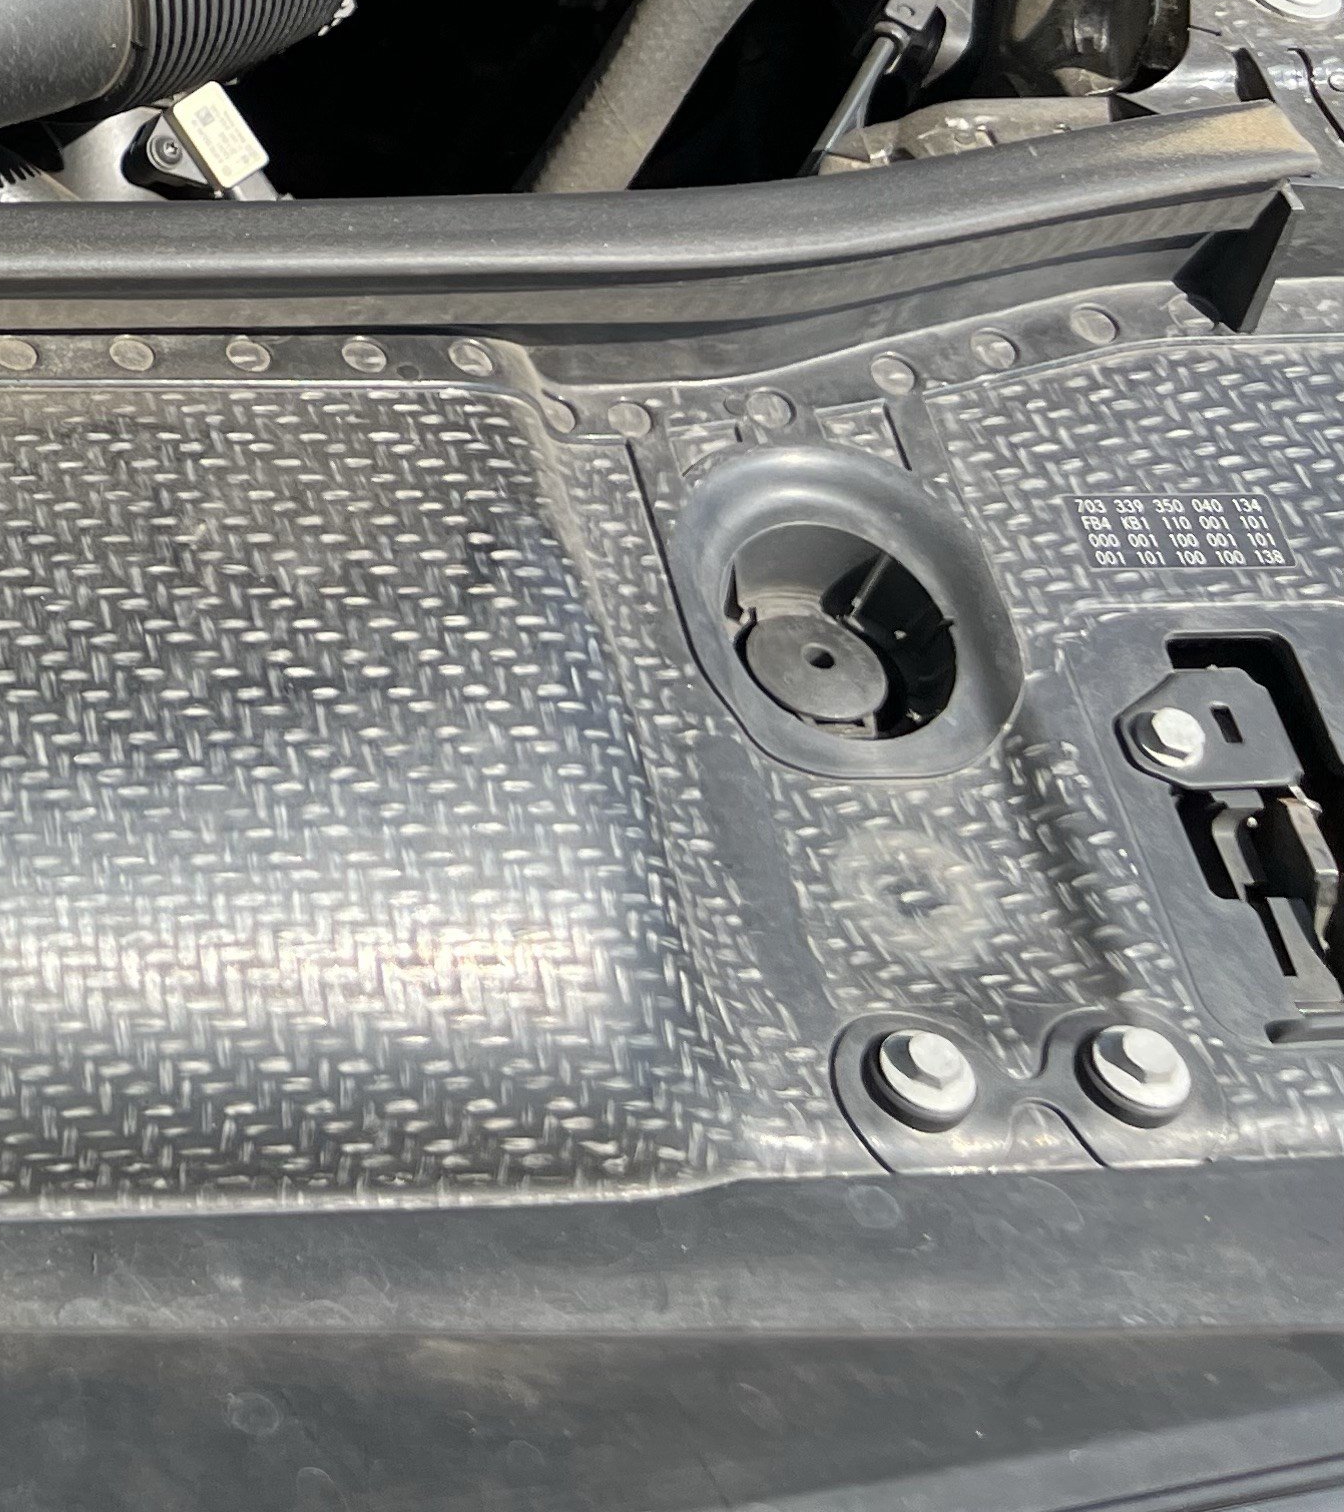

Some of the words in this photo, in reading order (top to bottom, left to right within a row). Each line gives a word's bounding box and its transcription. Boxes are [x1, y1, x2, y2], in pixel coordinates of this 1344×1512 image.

[1075, 499, 1107, 513] 703
[1113, 499, 1145, 513] 339
[1152, 499, 1185, 513] 350
[1191, 498, 1224, 513] 040
[1232, 498, 1262, 513] 134
[1081, 516, 1112, 531] FB4
[1120, 516, 1150, 530] KB1
[1162, 516, 1192, 530] 110
[1199, 515, 1230, 530] 001
[1239, 515, 1269, 530] 101
[1088, 533, 1121, 548] 000
[1128, 533, 1159, 548] 001
[1169, 533, 1200, 548] 100
[1206, 533, 1237, 547] 001
[1247, 533, 1276, 547] 101
[1095, 550, 1126, 565] 001
[1137, 550, 1166, 565] 101
[1176, 550, 1207, 565] 100
[1215, 550, 1247, 565] 100
[1254, 550, 1285, 565] 138
